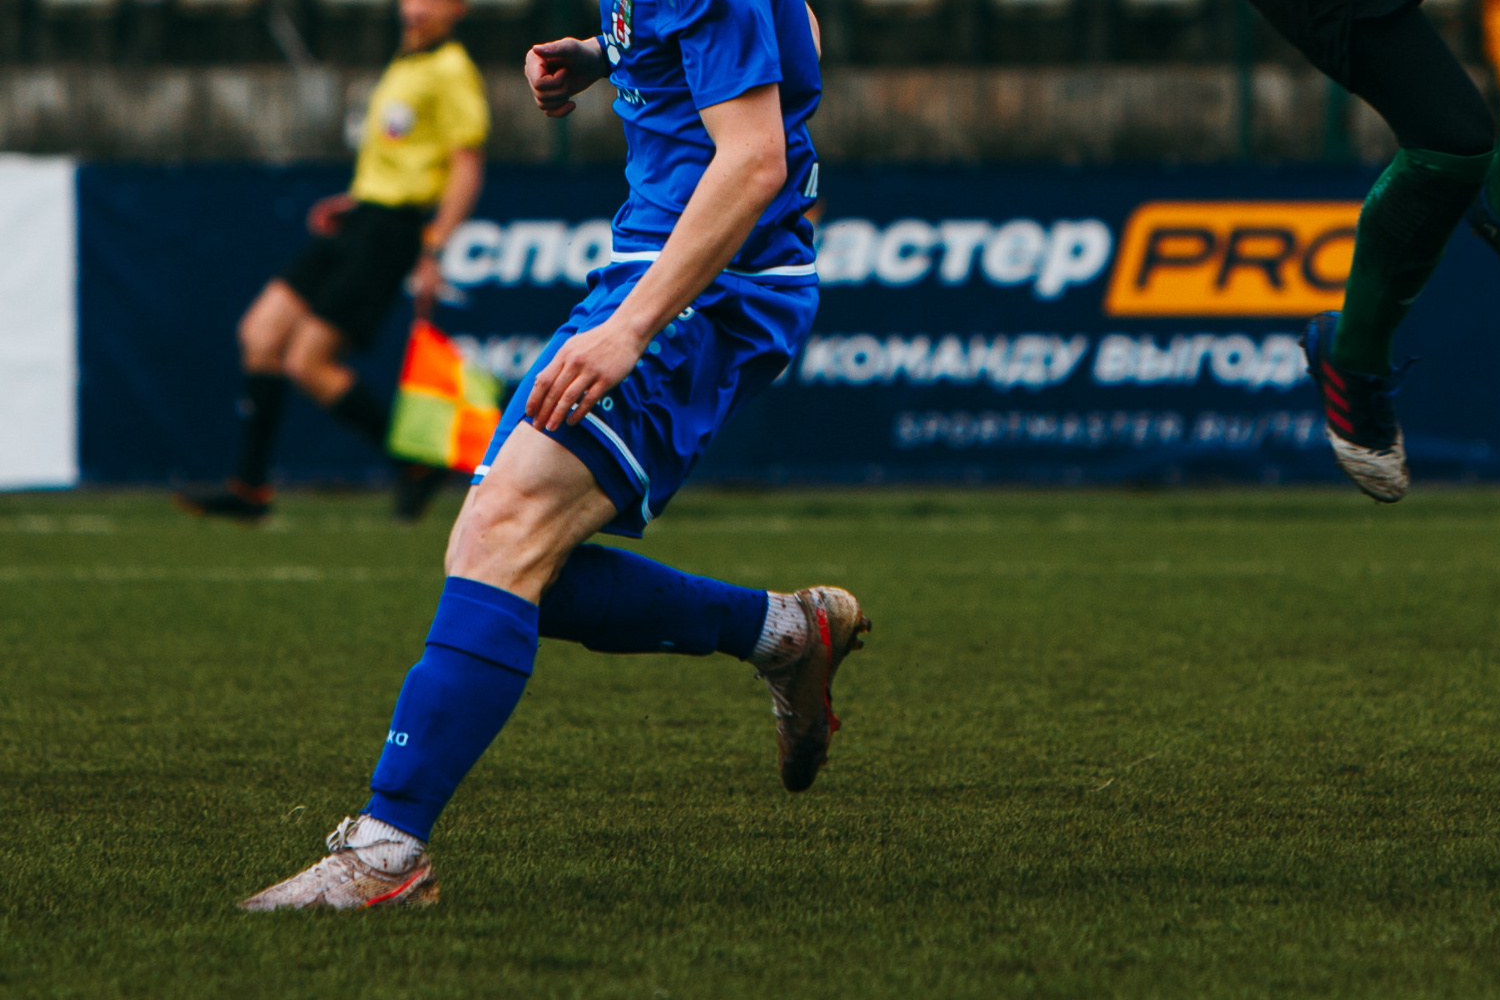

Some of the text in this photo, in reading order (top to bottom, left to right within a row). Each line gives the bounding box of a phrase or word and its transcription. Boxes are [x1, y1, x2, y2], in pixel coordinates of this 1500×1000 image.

[804, 334, 1307, 390] КОМАНДУ ВЫГОД
[895, 412, 1328, 446] SPORTMASTER.RU/TE
